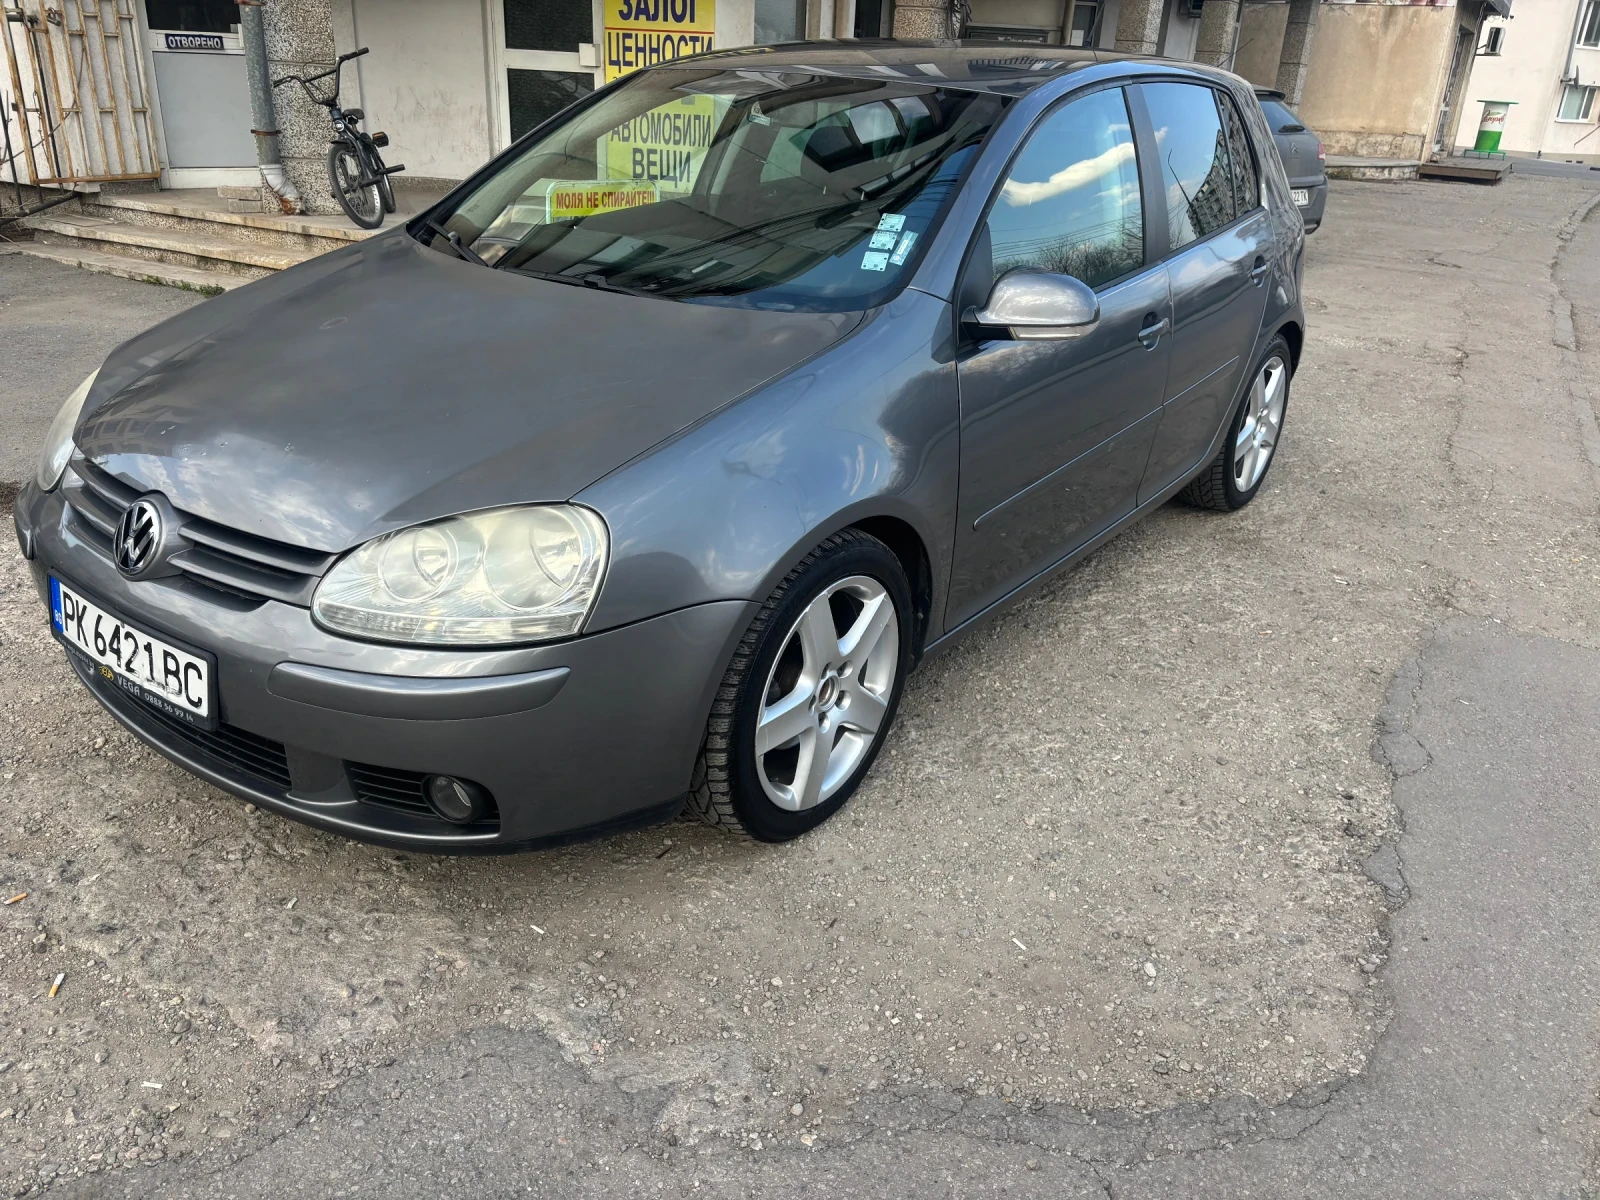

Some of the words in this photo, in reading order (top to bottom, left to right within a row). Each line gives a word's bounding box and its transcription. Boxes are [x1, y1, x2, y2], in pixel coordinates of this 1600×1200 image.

[168, 35, 221, 49] ОТВОРЕНО
[632, 147, 691, 188] ВЕЩИ
[556, 192, 583, 209] МОЛЯ
[586, 191, 599, 208] НЕ
[116, 674, 141, 697] VEGA
